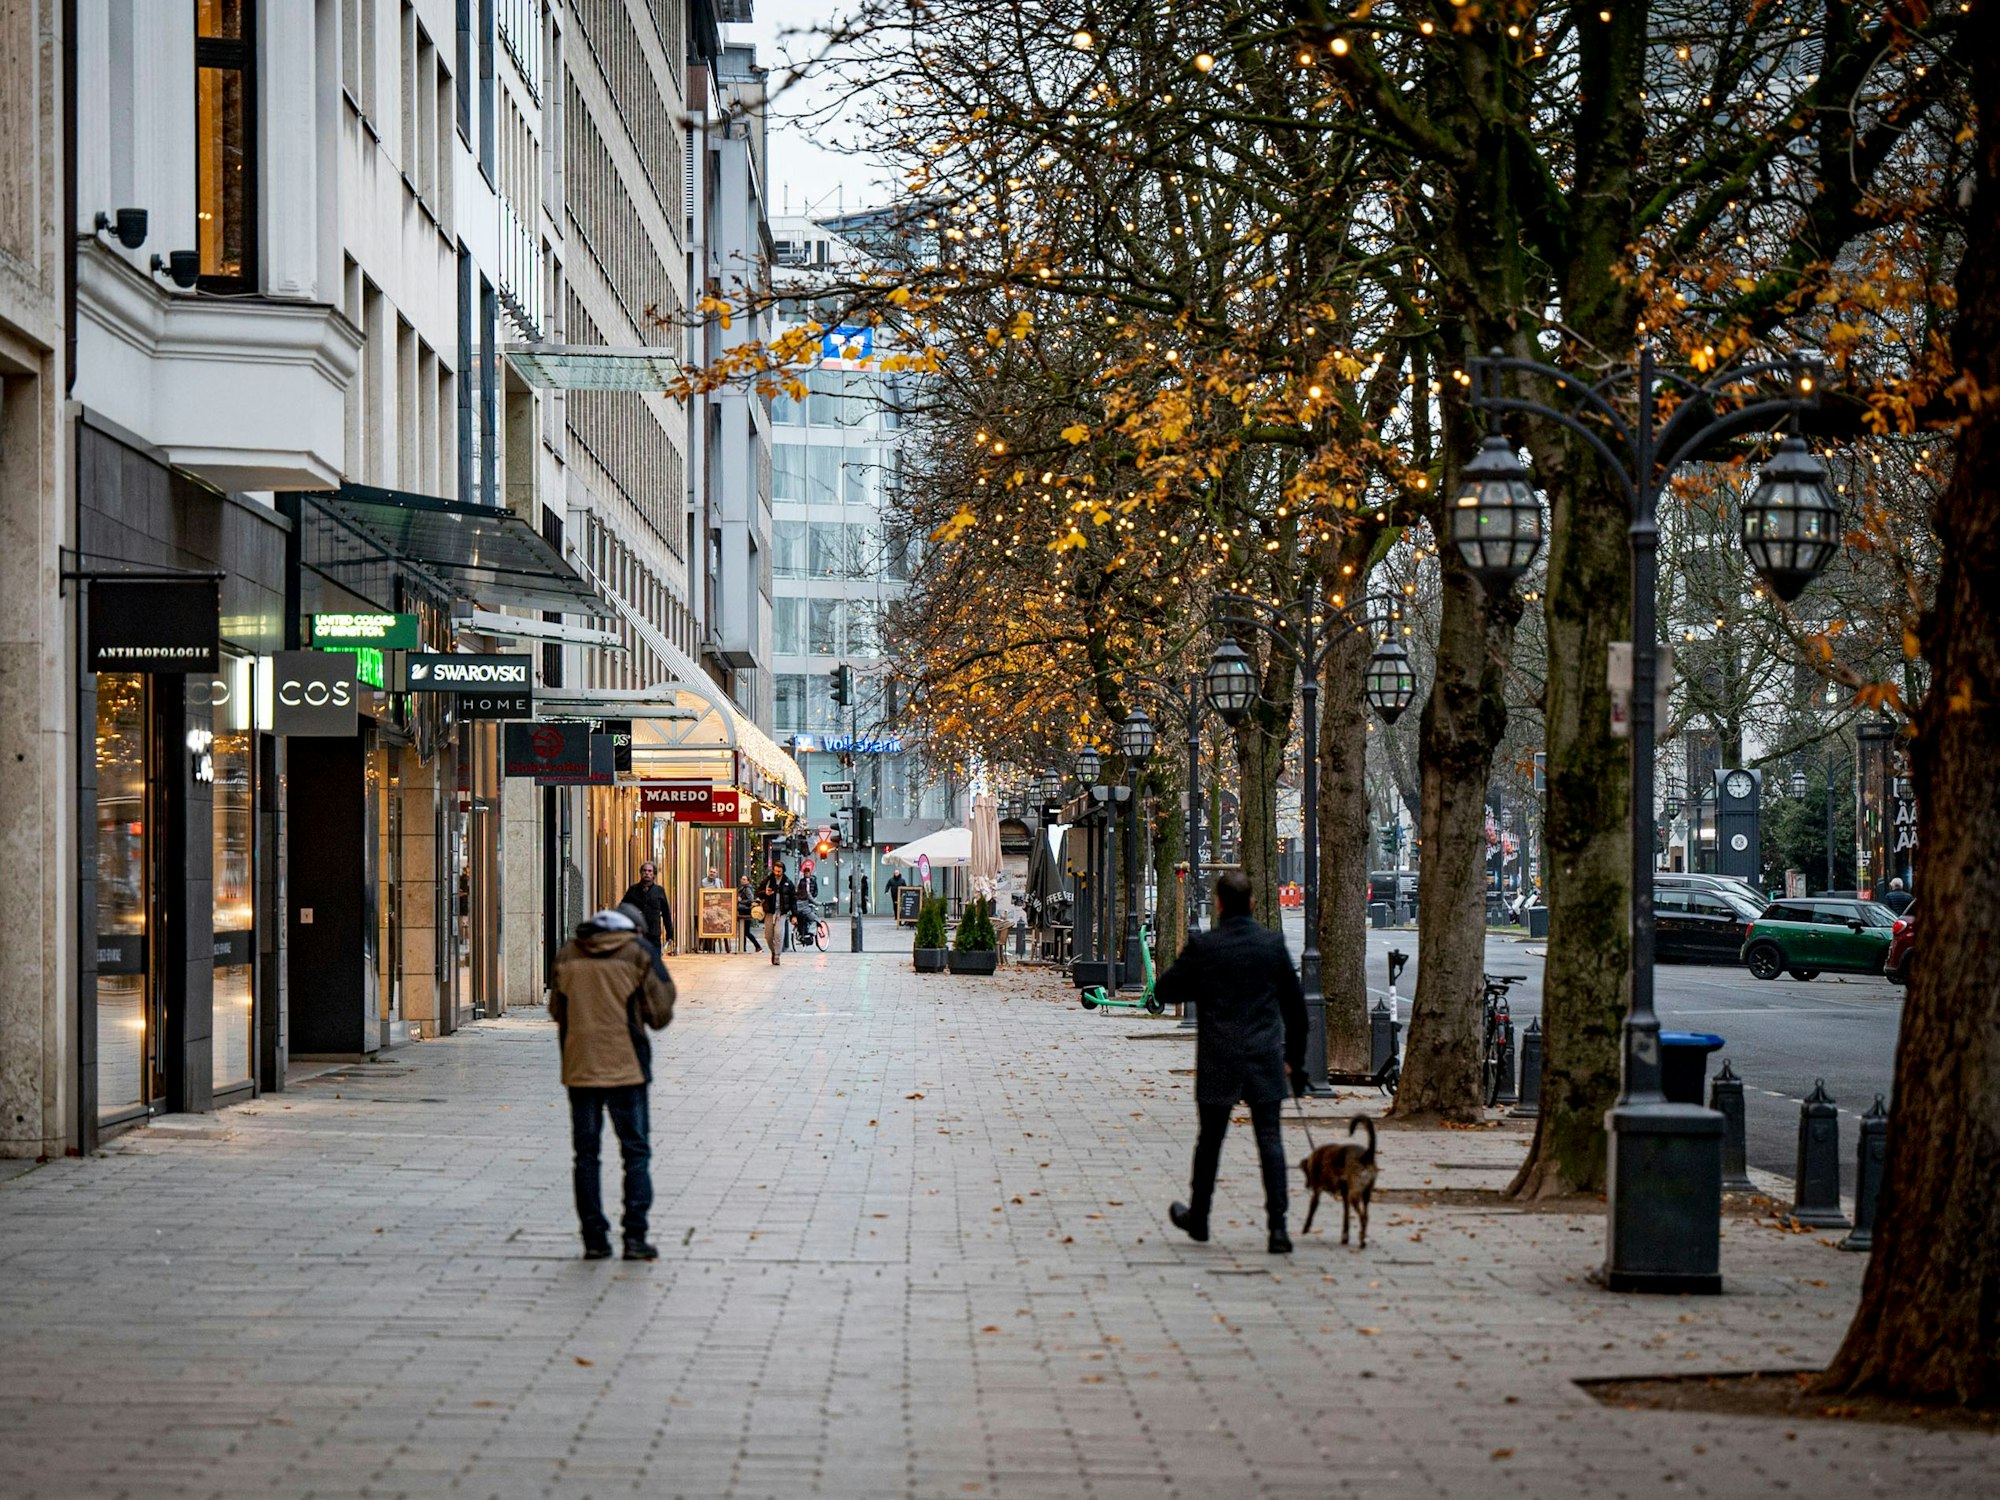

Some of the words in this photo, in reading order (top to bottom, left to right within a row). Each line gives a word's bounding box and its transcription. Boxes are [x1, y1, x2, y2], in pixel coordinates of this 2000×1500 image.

[315, 614, 353, 626] UNITED
[353, 614, 396, 626] COLORS
[314, 625, 330, 636] OF
[97, 647, 210, 659] ANTHROPOLOGIE
[433, 664, 526, 682] SWAROVSKI
[279, 680, 350, 706] COS
[462, 698, 527, 711] HOME
[644, 788, 709, 803] MAREDO
